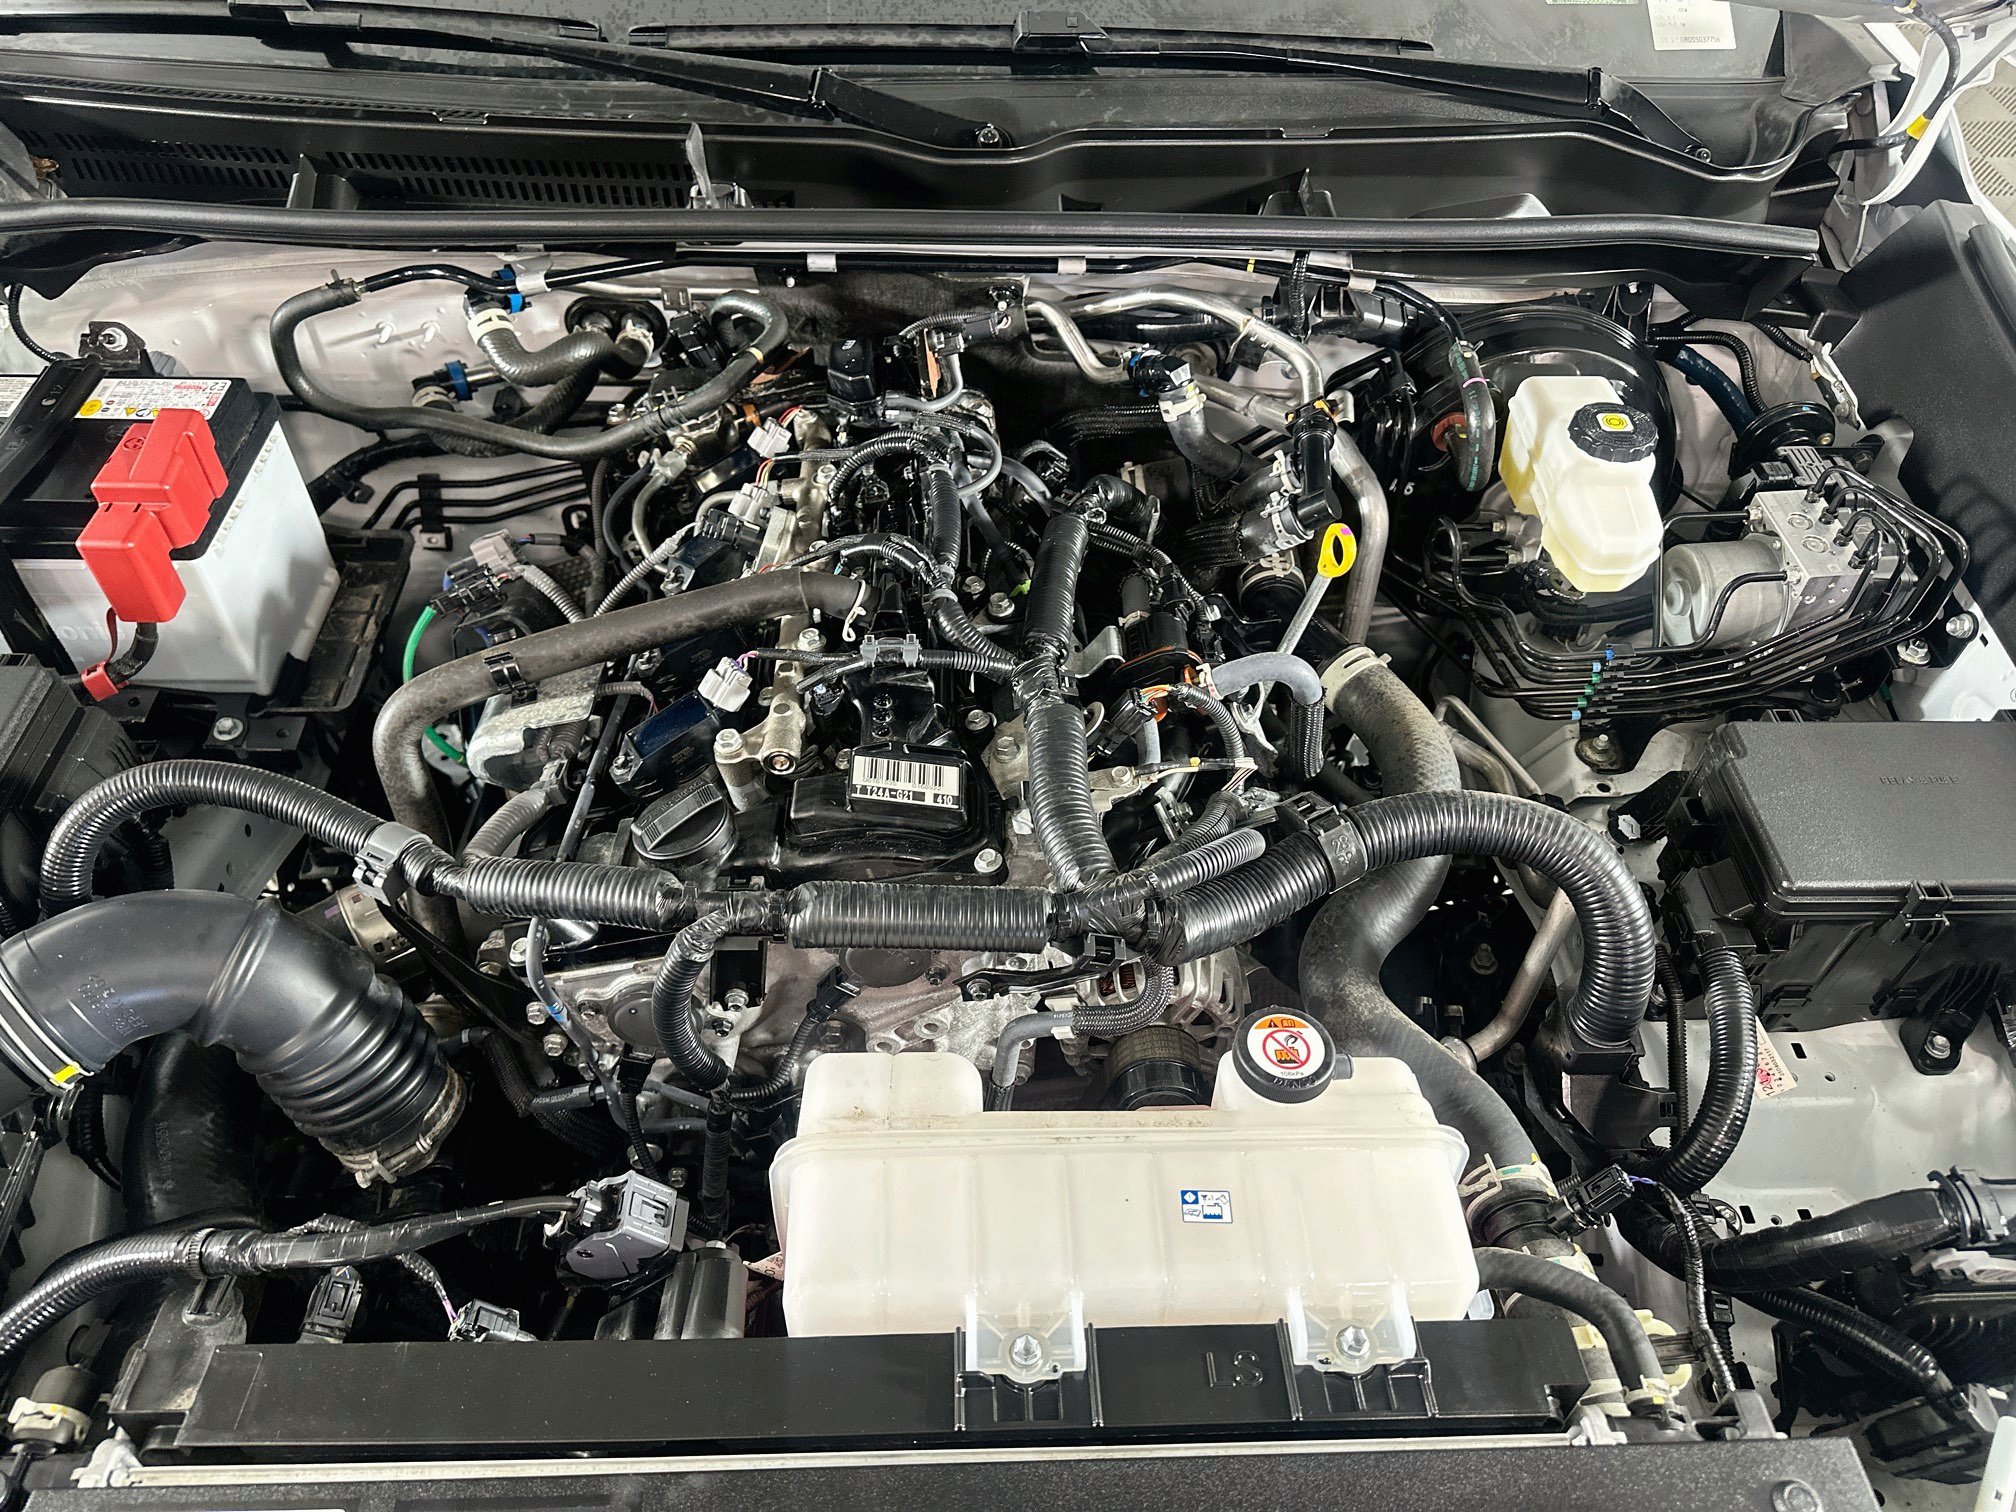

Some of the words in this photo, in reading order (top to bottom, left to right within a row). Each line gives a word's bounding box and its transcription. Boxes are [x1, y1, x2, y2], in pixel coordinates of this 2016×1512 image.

[1880, 775, 1915, 785] RELAY
[855, 785, 862, 794] T
[867, 786, 913, 801] T24A-G21
[937, 796, 953, 805] 410
[1206, 1350, 1263, 1387] LS
